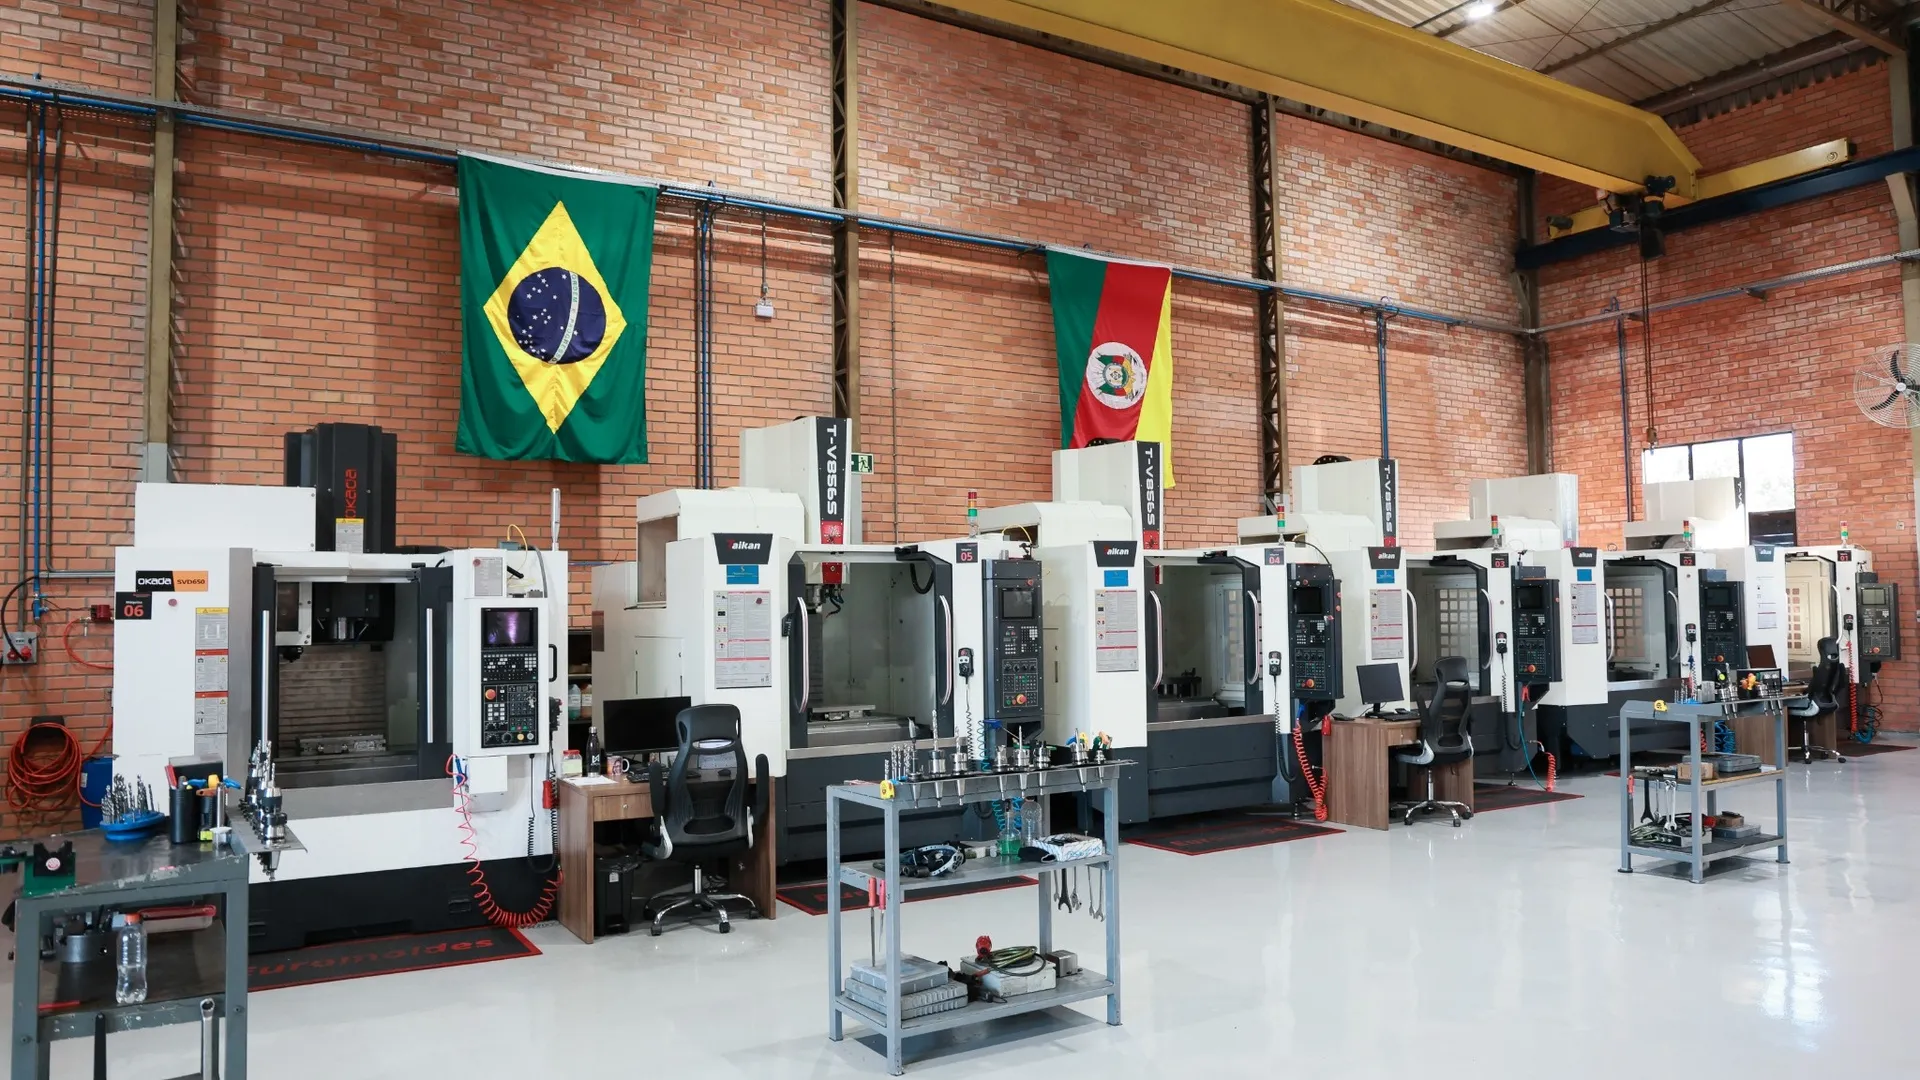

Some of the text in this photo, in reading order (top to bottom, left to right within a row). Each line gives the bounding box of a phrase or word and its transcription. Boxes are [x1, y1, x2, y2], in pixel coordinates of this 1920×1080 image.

[826, 424, 838, 516] T-V856S
[1145, 447, 1156, 526] T-V856S
[727, 539, 761, 550] Taikan
[960, 551, 973, 562] 05
[1269, 556, 1281, 565] 04
[1495, 560, 1505, 568] 03
[123, 604, 145, 617] 06
